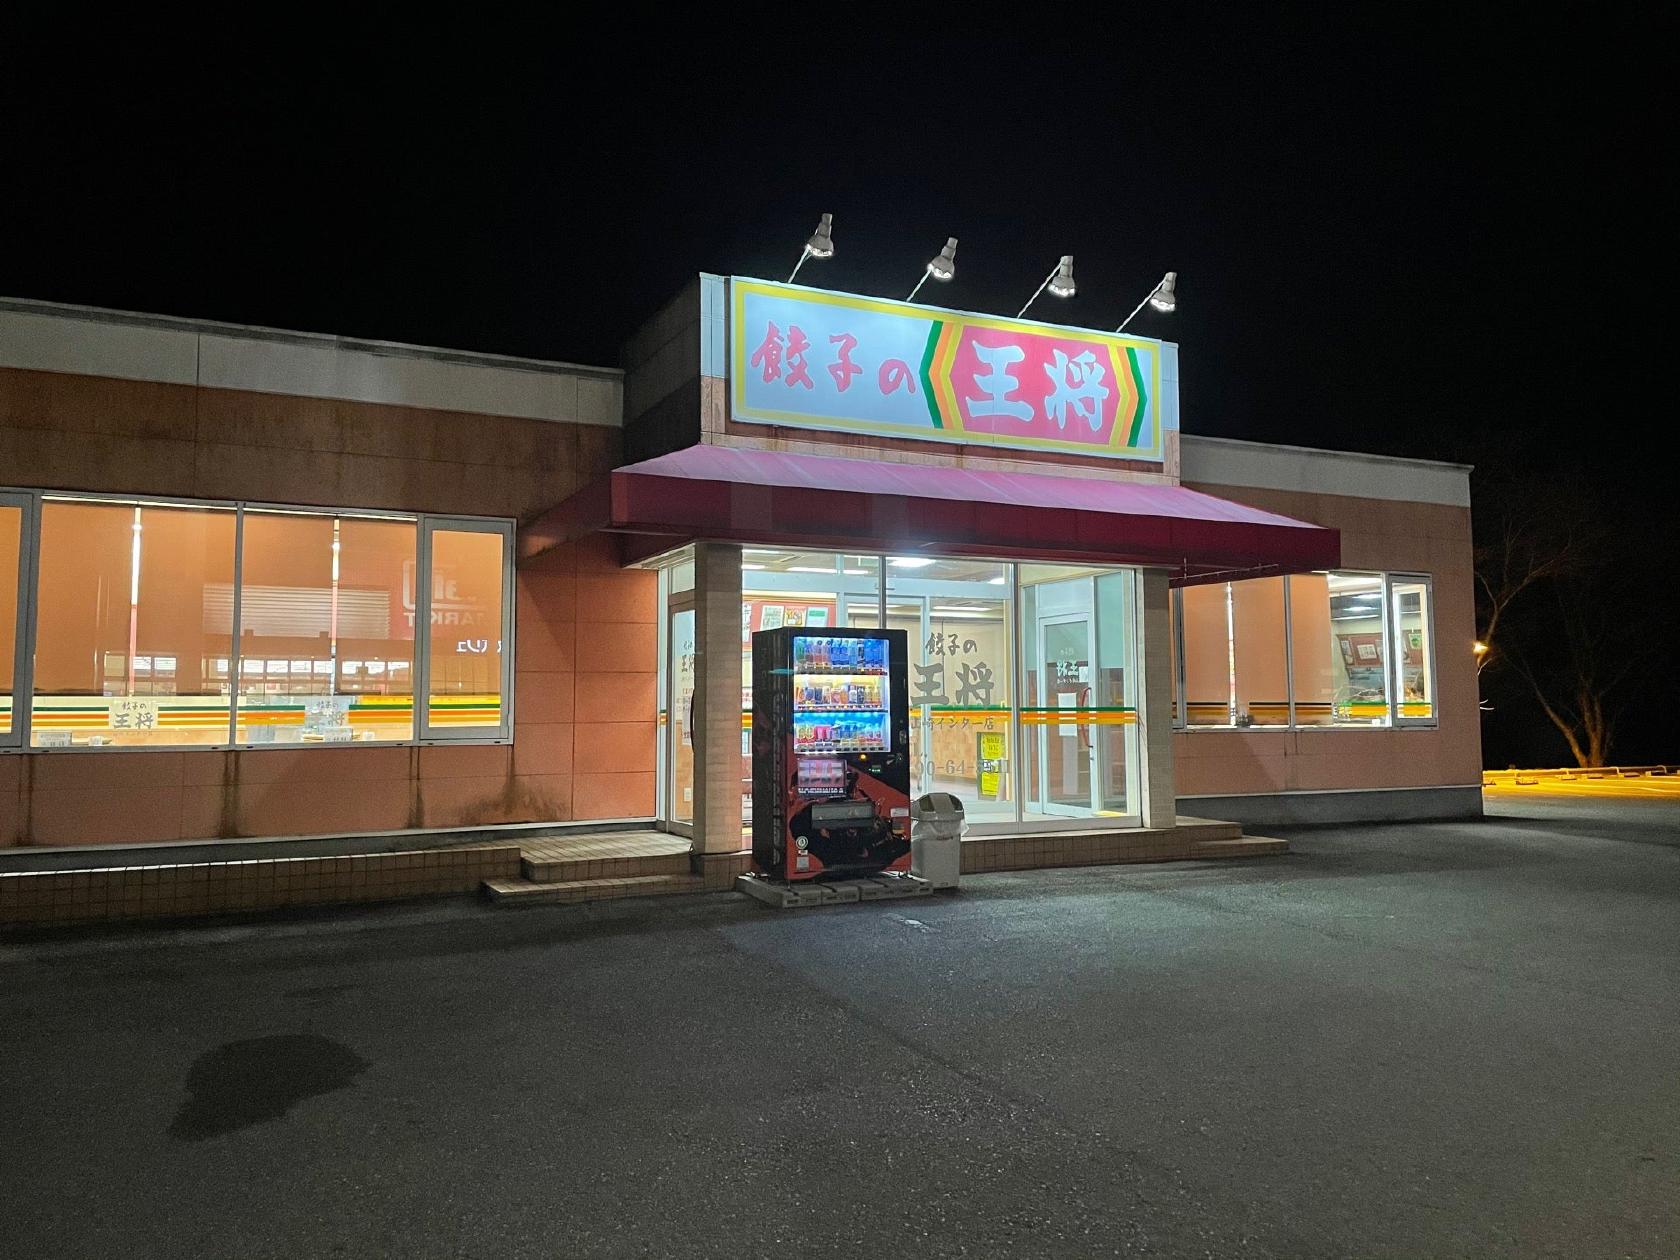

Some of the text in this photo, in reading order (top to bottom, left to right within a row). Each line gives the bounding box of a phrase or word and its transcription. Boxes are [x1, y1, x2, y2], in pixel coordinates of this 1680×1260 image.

[751, 320, 1110, 432] 餃子の 王将
[925, 632, 978, 657] 餃子の
[910, 662, 994, 706] 王将
[113, 712, 154, 729] 王将
